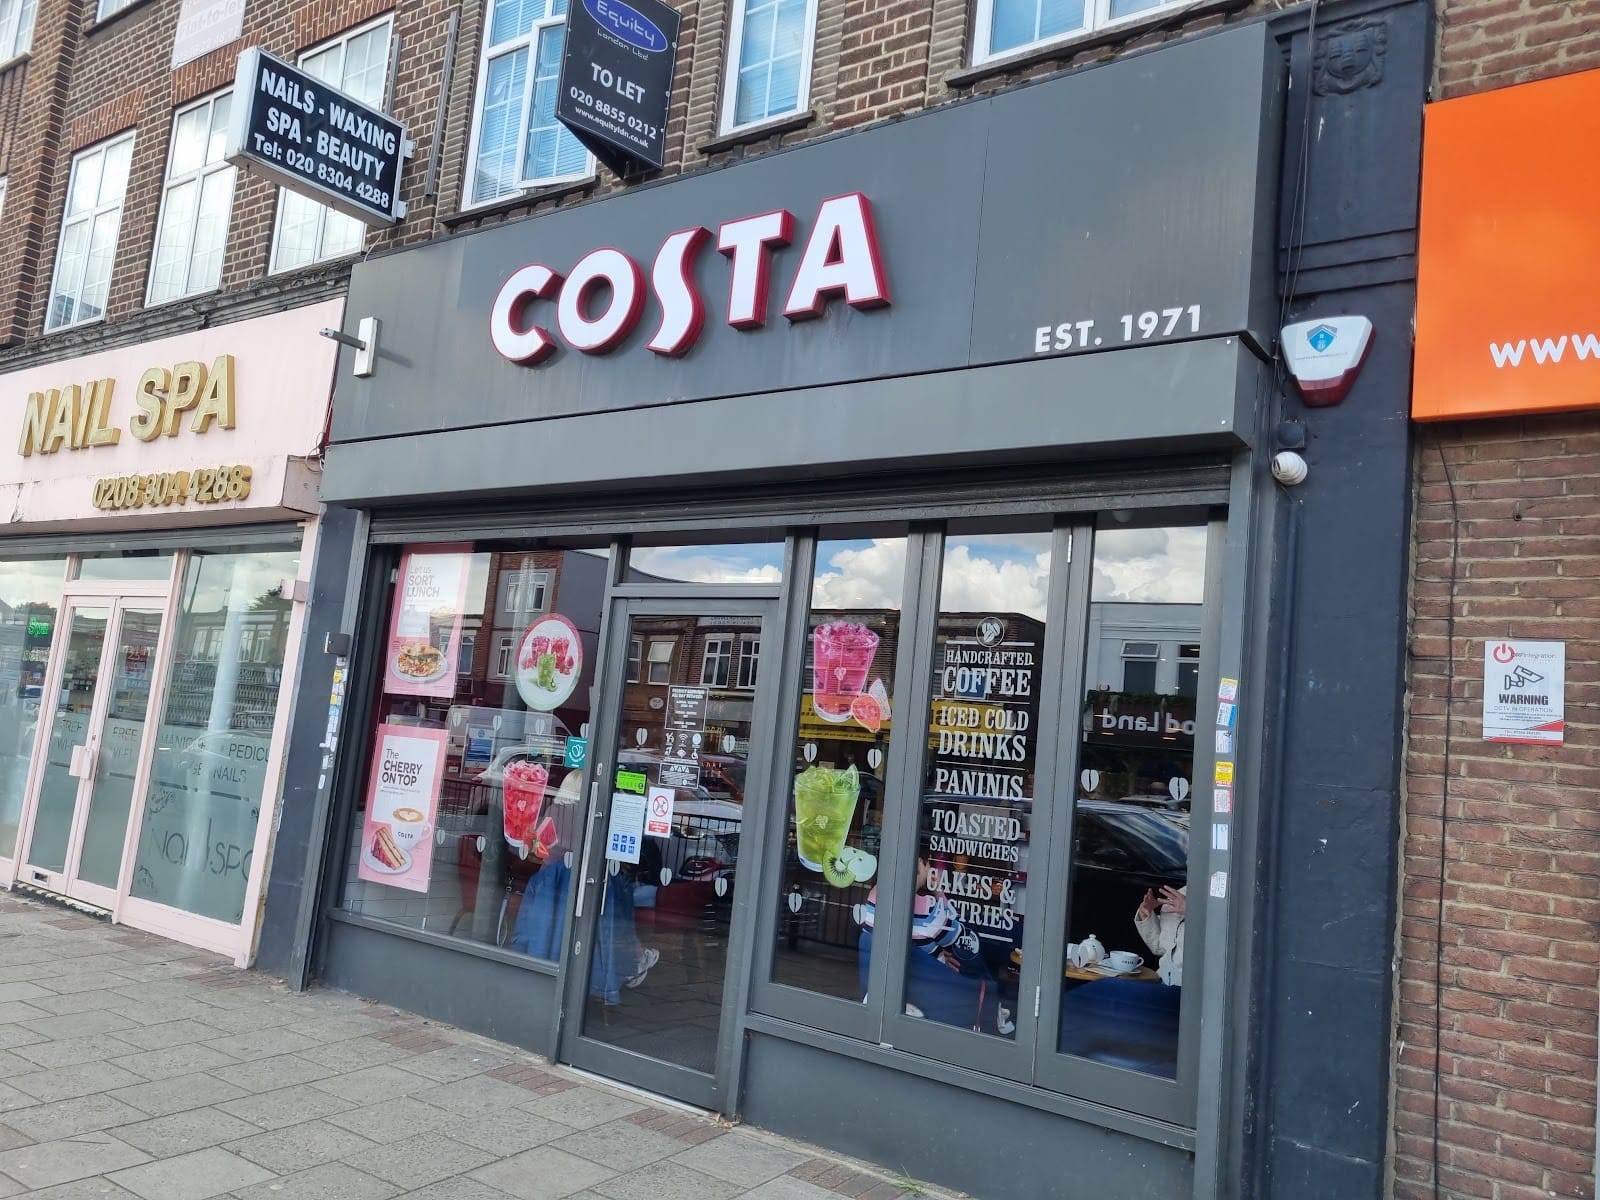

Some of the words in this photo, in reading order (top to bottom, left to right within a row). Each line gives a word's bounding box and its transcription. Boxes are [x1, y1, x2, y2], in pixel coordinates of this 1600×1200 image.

[597, 0, 655, 47] Equity
[597, 28, 629, 50] London
[632, 47, 649, 60] Ltd
[591, 62, 613, 88] TO
[616, 76, 646, 104] LET
[329, 102, 396, 155] WAXING
[570, 86, 593, 107] 020
[595, 99, 626, 124] 8855
[627, 115, 657, 140] 0212
[575, 106, 649, 149] www.equityldn.co.uk
[266, 107, 302, 144] SPA
[316, 130, 385, 181] BEAUTY
[254, 133, 282, 160] Tel:
[286, 148, 314, 174] 020
[317, 163, 352, 192] 8304
[356, 181, 390, 209] 4288
[489, 191, 892, 366] COSTA
[1034, 319, 1102, 353] EST.
[1119, 304, 1201, 342] 1971
[18, 377, 121, 457] NAIL
[130, 353, 236, 442] SPA
[92, 473, 144, 510] 0208
[142, 470, 188, 505] 304
[188, 464, 252, 504] 4288
[408, 575, 435, 587] SORT
[423, 566, 432, 574] us
[406, 586, 441, 598] LUNCH
[946, 649, 1034, 667] HANDCRAFTED
[943, 666, 1032, 697] COFFEE
[1498, 693, 1549, 706] WARNING
[939, 706, 980, 728] ICED
[984, 709, 1029, 731] COLD
[385, 748, 400, 760] The
[937, 729, 1027, 762] DRINKS
[381, 771, 396, 784] ON
[397, 773, 417, 787] TOP
[383, 759, 423, 776] CHERRY
[935, 767, 1024, 802] PANINIS
[932, 808, 1022, 843] TOASTED
[929, 835, 1019, 864] SANDWICHES
[926, 867, 993, 900] CAKES
[999, 879, 1016, 905] &
[925, 894, 1014, 932] PASTRIES
